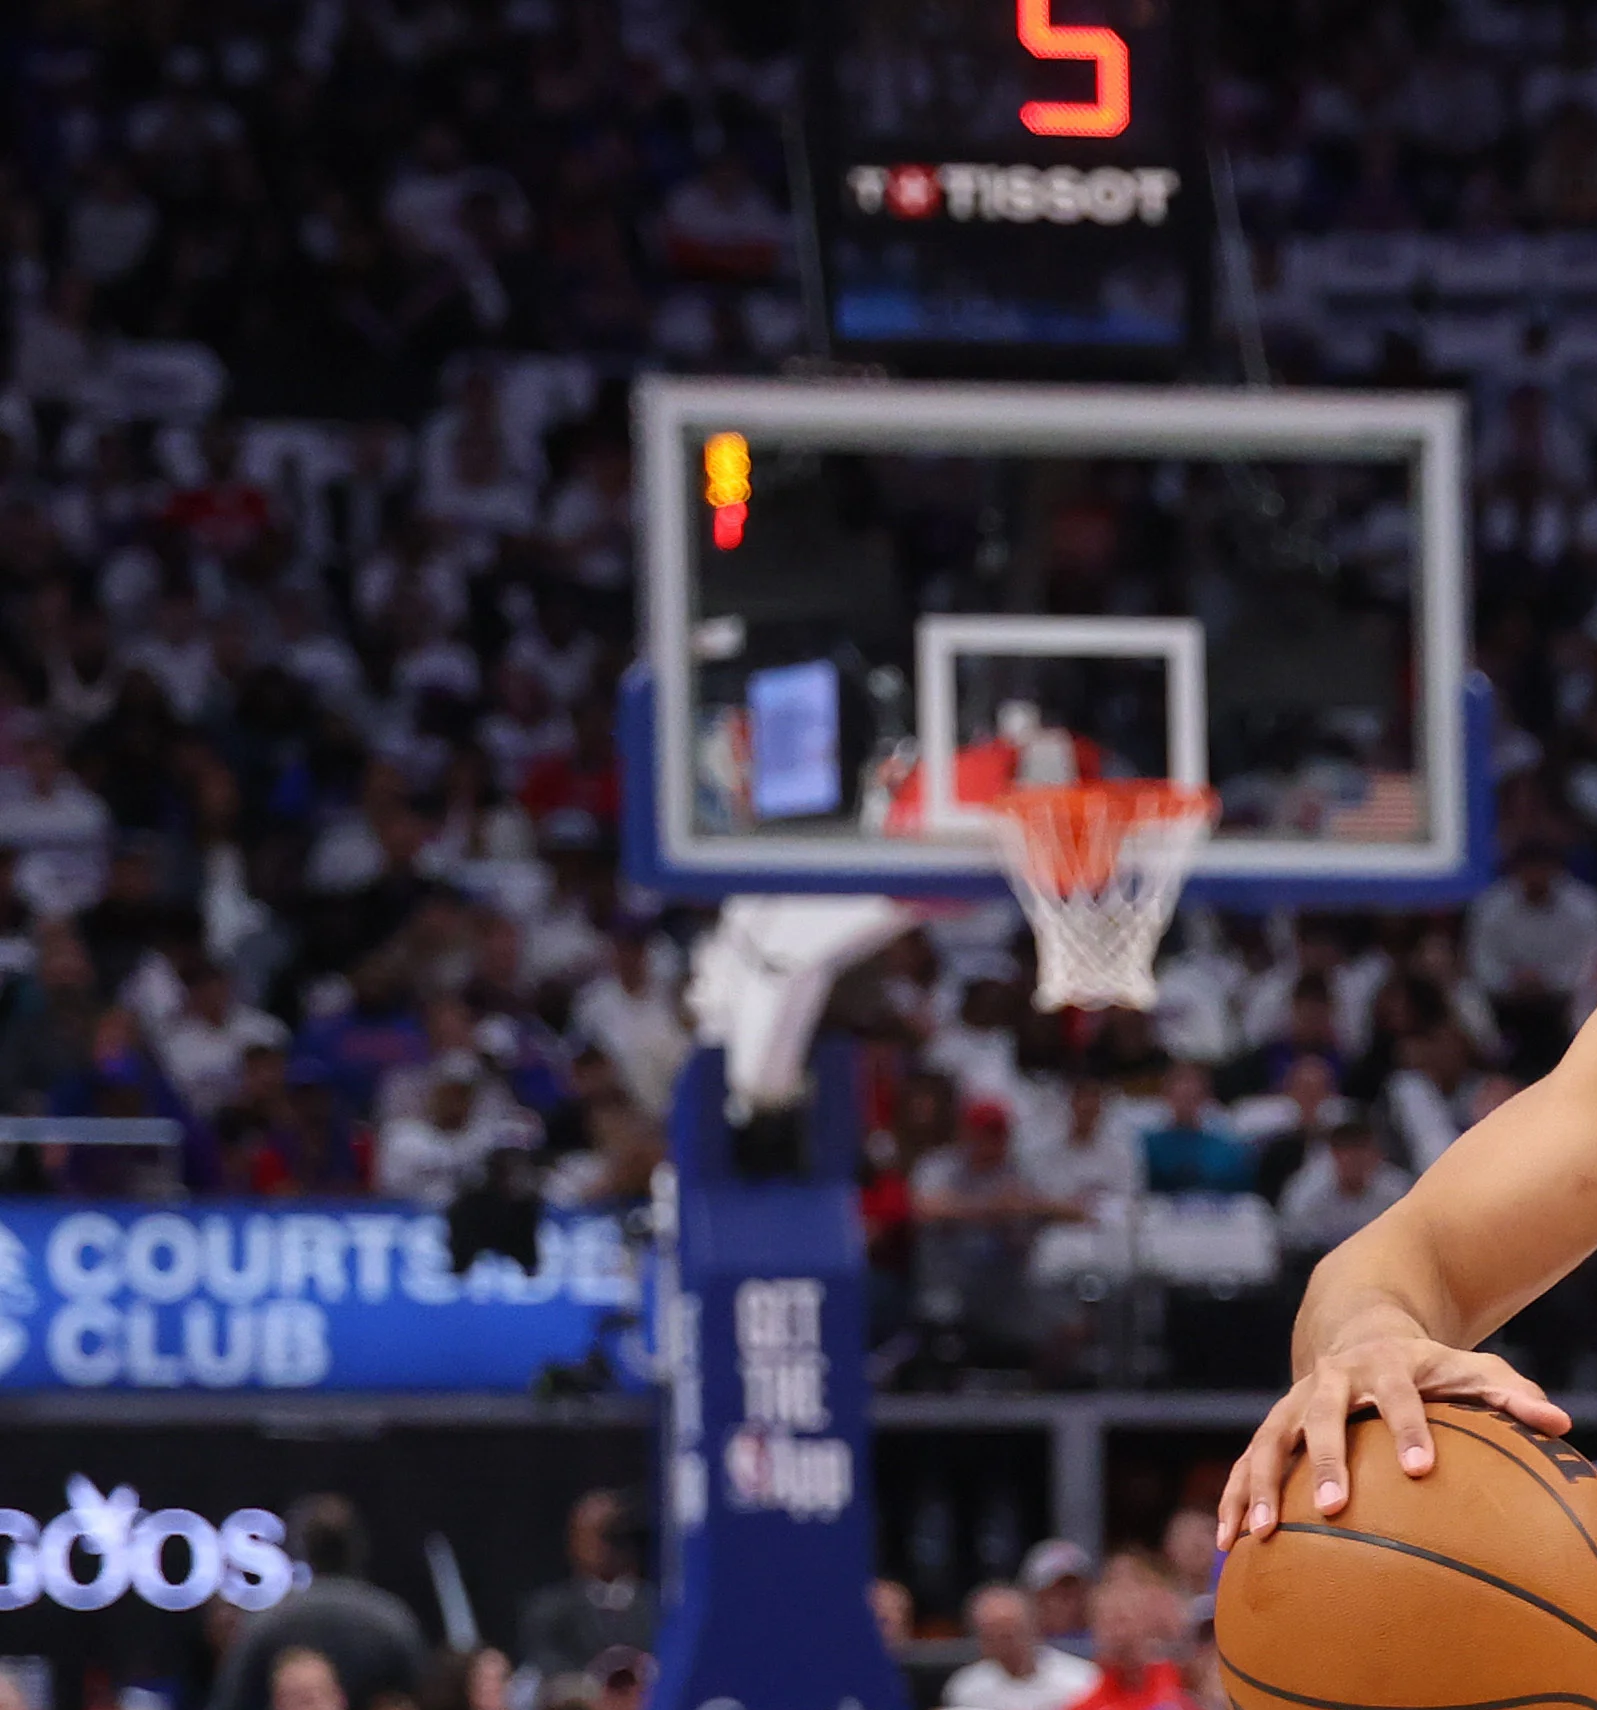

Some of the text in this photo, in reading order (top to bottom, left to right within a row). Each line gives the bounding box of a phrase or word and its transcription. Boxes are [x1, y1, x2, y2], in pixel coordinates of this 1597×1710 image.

[1017, 0, 1130, 138] 5
[938, 163, 1181, 226] TISSOT
[47, 1302, 332, 1388] CLUB
